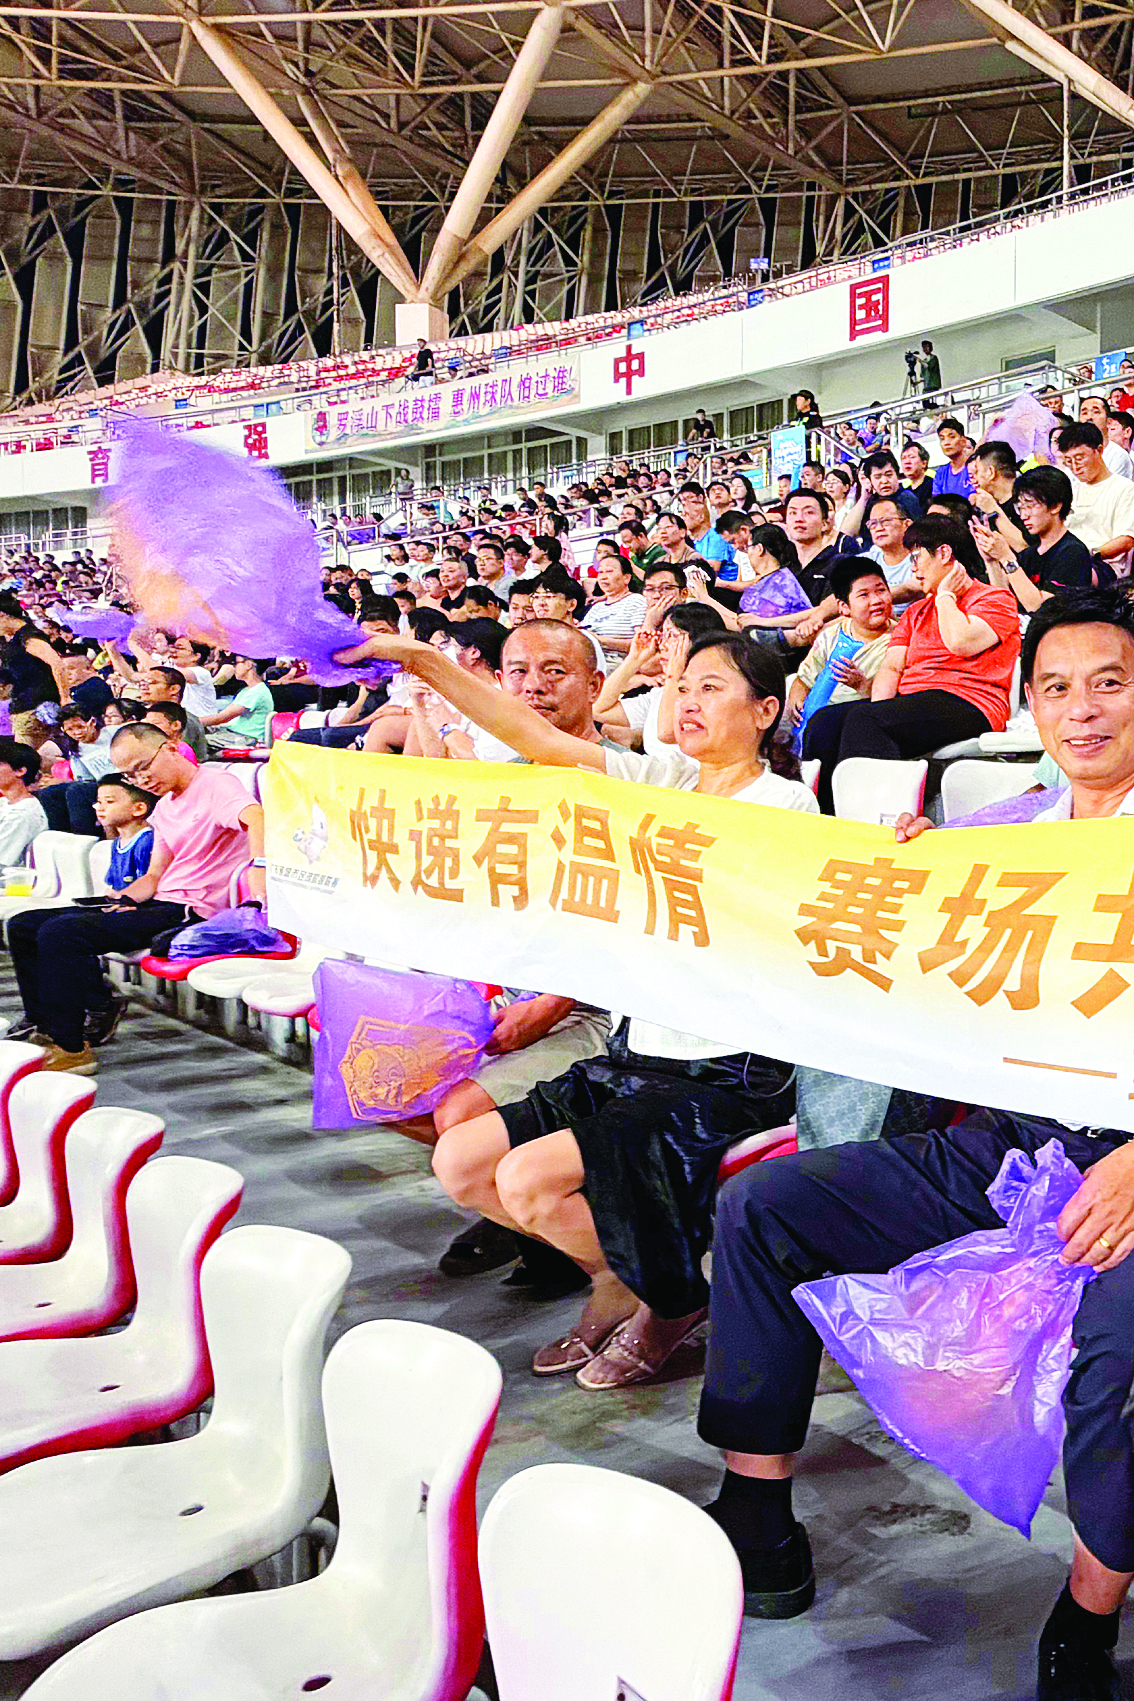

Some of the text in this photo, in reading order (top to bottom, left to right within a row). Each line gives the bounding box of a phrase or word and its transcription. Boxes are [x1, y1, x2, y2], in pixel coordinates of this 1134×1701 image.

[335, 392, 442, 438] 罗浮山下战鼓擂
[86, 446, 113, 485] 育
[348, 786, 719, 948] 快递有温情
